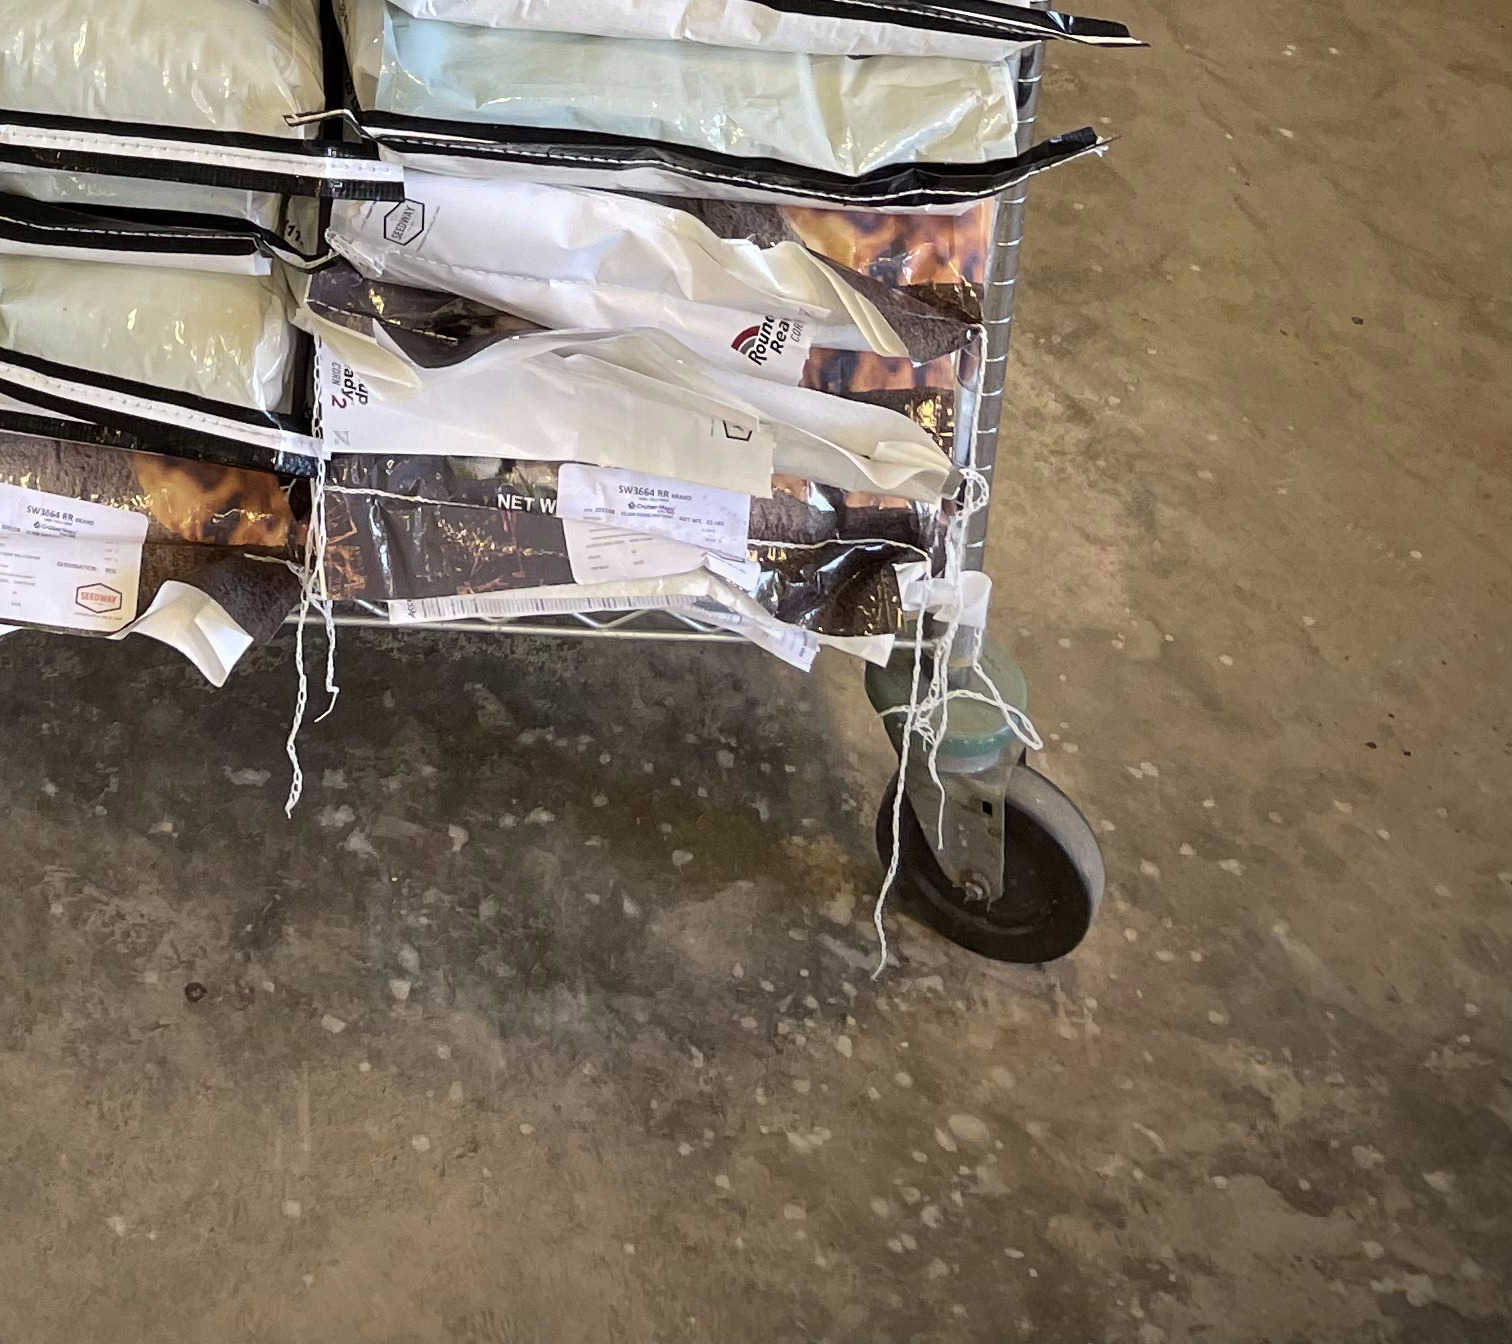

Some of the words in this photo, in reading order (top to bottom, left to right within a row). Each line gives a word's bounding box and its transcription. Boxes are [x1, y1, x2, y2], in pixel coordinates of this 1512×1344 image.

[390, 203, 416, 242] SEEDWAY
[331, 394, 347, 410] 2
[618, 484, 655, 497] SW3664
[657, 489, 669, 497] RR
[497, 494, 533, 510] NET
[62, 513, 74, 522] RR
[80, 591, 118, 603] SEEDWAY
